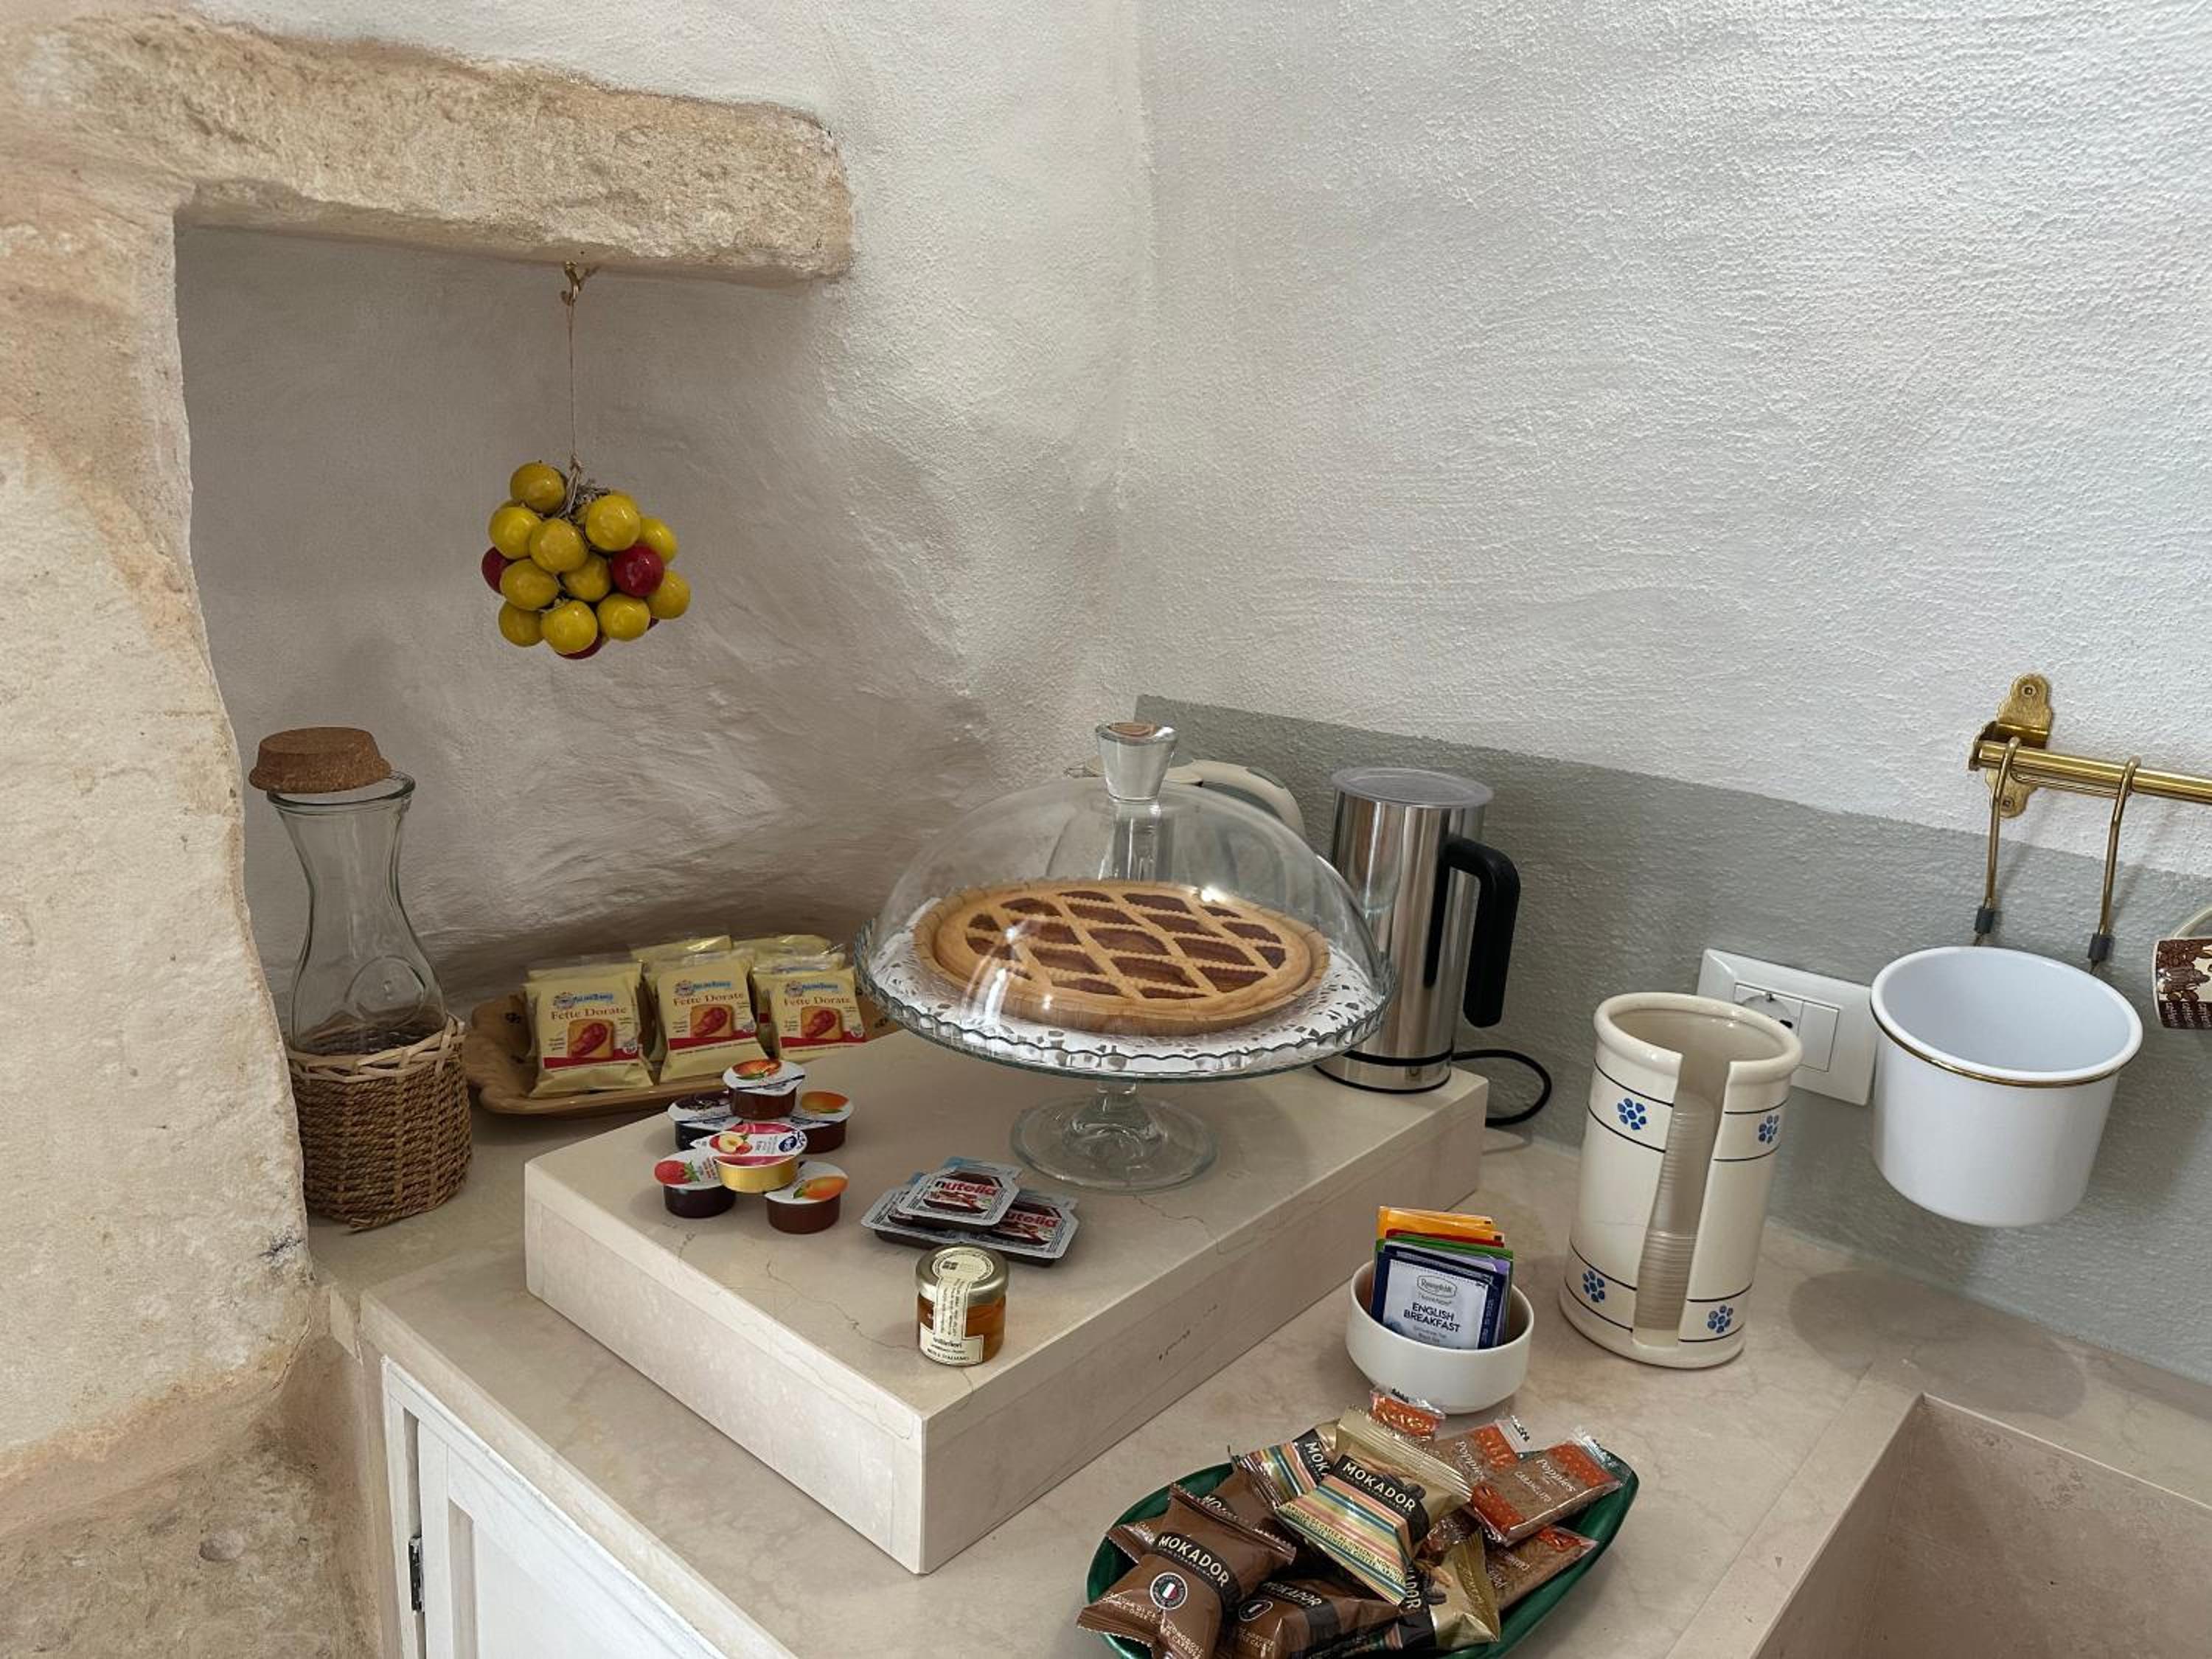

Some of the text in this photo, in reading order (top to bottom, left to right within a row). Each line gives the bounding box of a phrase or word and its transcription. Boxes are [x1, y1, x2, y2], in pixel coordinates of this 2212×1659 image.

[704, 992, 744, 1002] Dorate
[551, 1006, 627, 1020] Fette Dorate
[934, 1180, 997, 1196] nutella
[1008, 1211, 1059, 1228] utella
[1403, 1310, 1461, 1333] BREAKFAST
[1412, 1303, 1454, 1322] ENGLISH
[1536, 1458, 1576, 1493] Poppies
[1342, 1461, 1416, 1513] MOKADOR
[1158, 1535, 1230, 1587] MOKADOR
